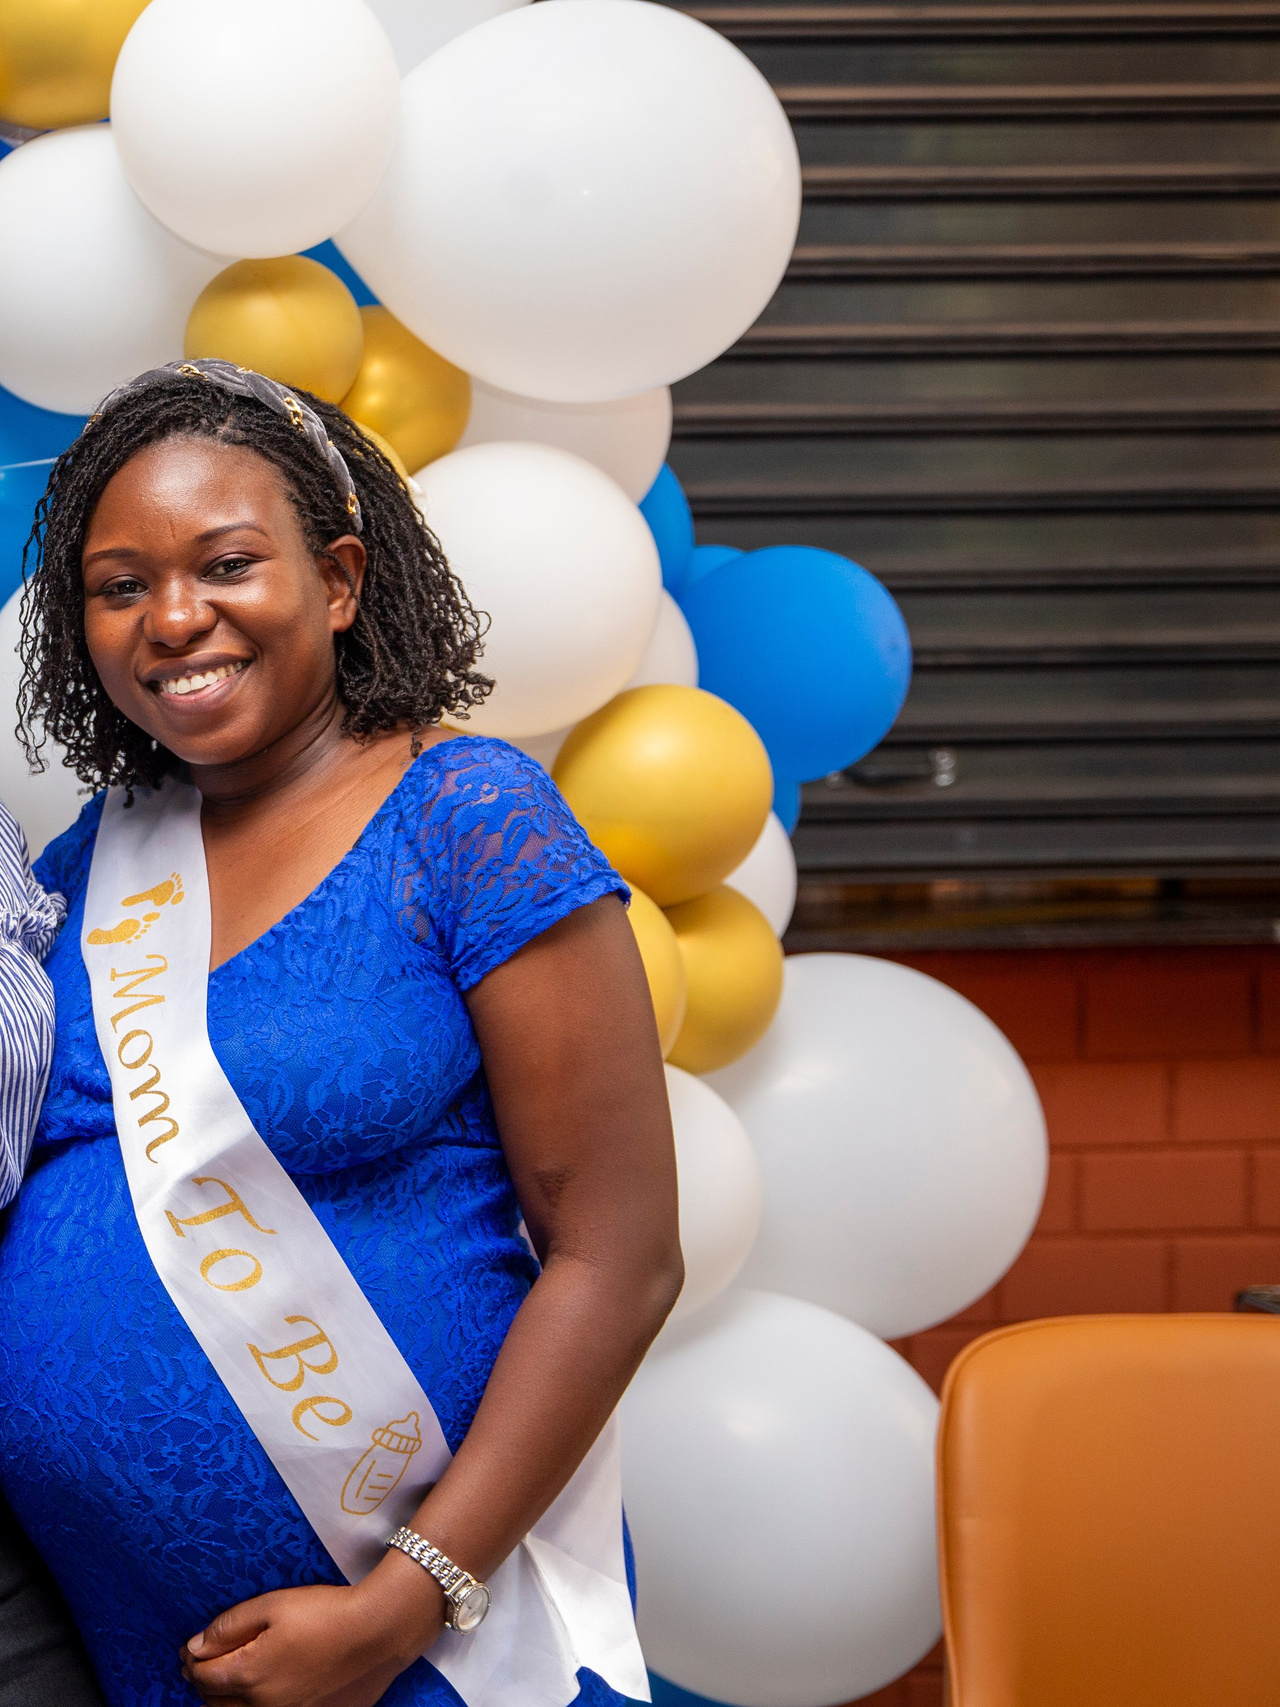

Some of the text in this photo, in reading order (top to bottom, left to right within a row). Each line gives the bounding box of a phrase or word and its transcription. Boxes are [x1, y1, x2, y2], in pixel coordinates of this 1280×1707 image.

[109, 954, 353, 1441] Mom To Be
